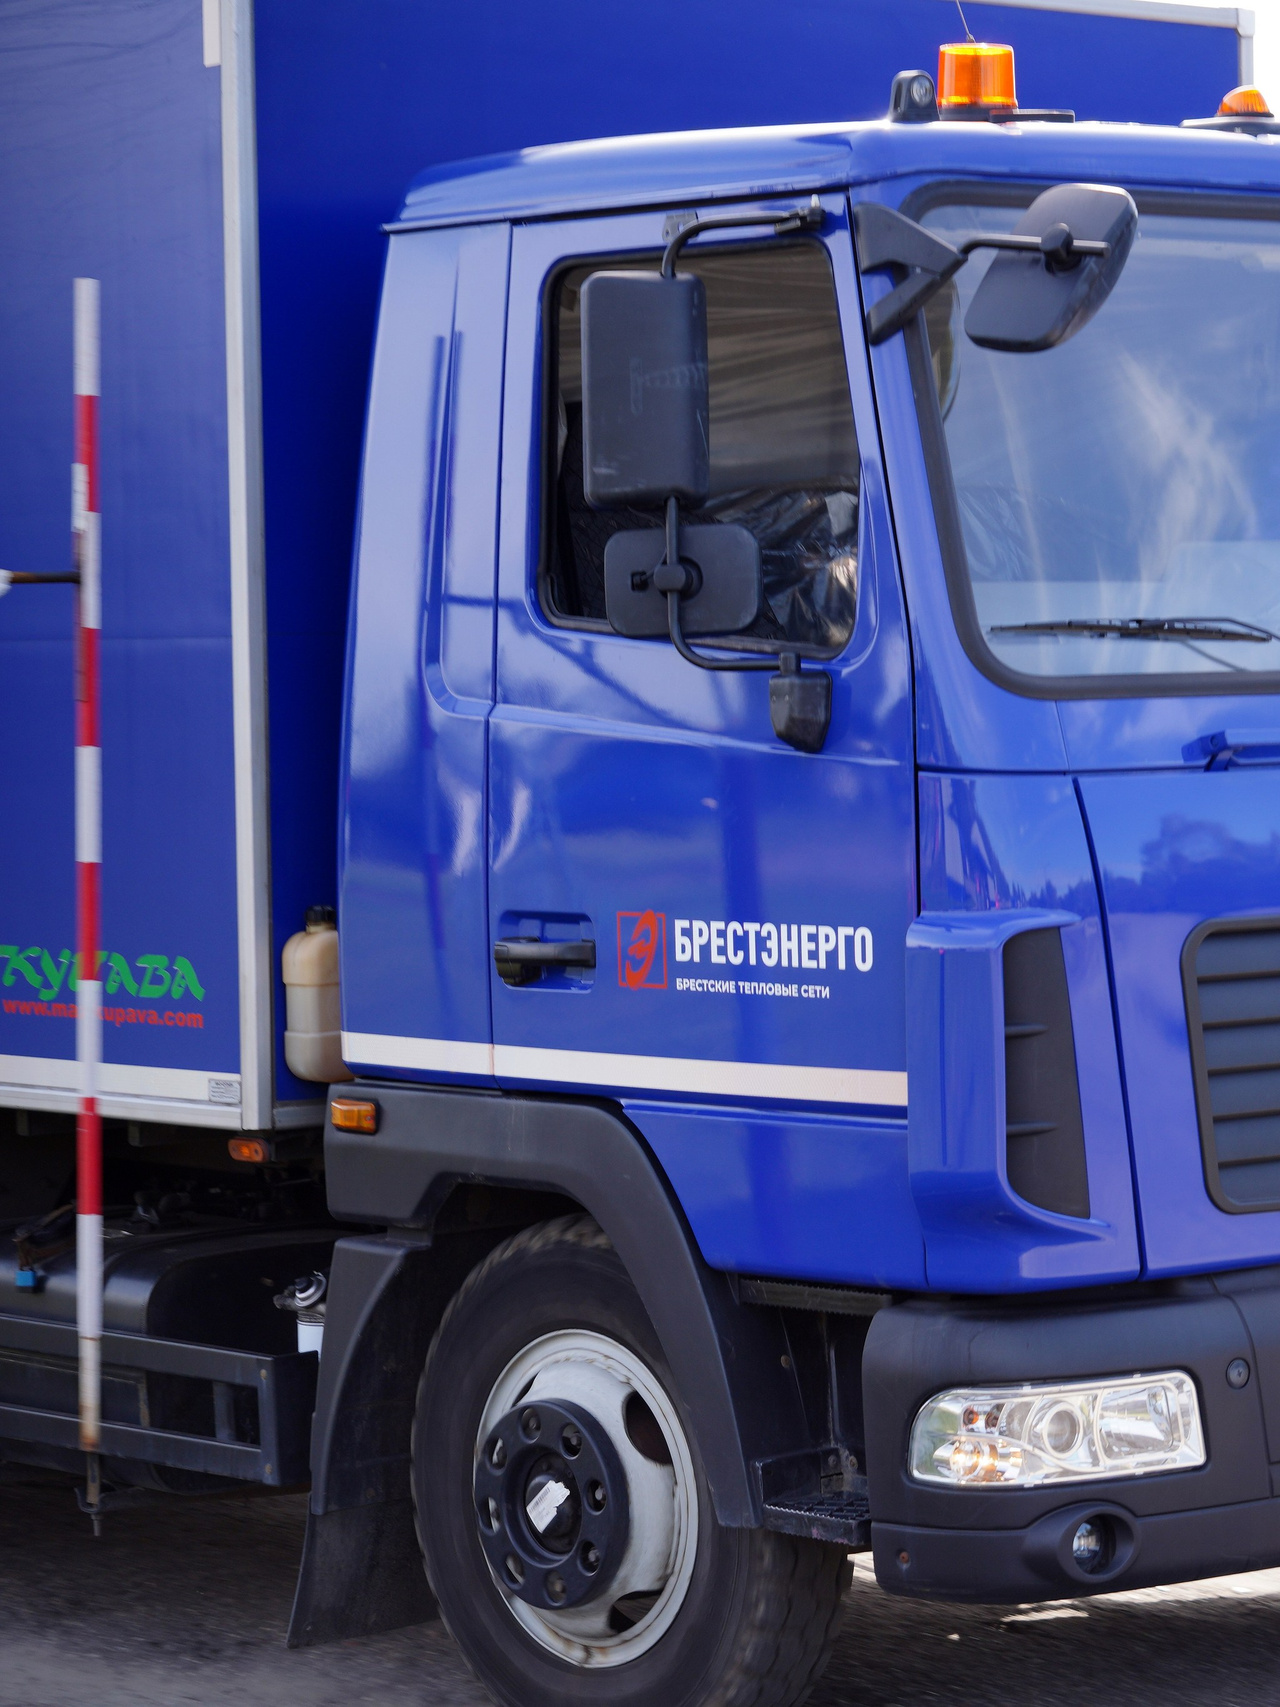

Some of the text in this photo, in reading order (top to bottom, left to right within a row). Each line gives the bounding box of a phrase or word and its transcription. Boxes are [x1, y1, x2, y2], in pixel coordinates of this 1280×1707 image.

[674, 918, 874, 972] БРЕСТЭНЕРГО
[676, 977, 830, 999] БРЕСТСКИЕ ТЕПЛОВЫЕ СЕТИ
